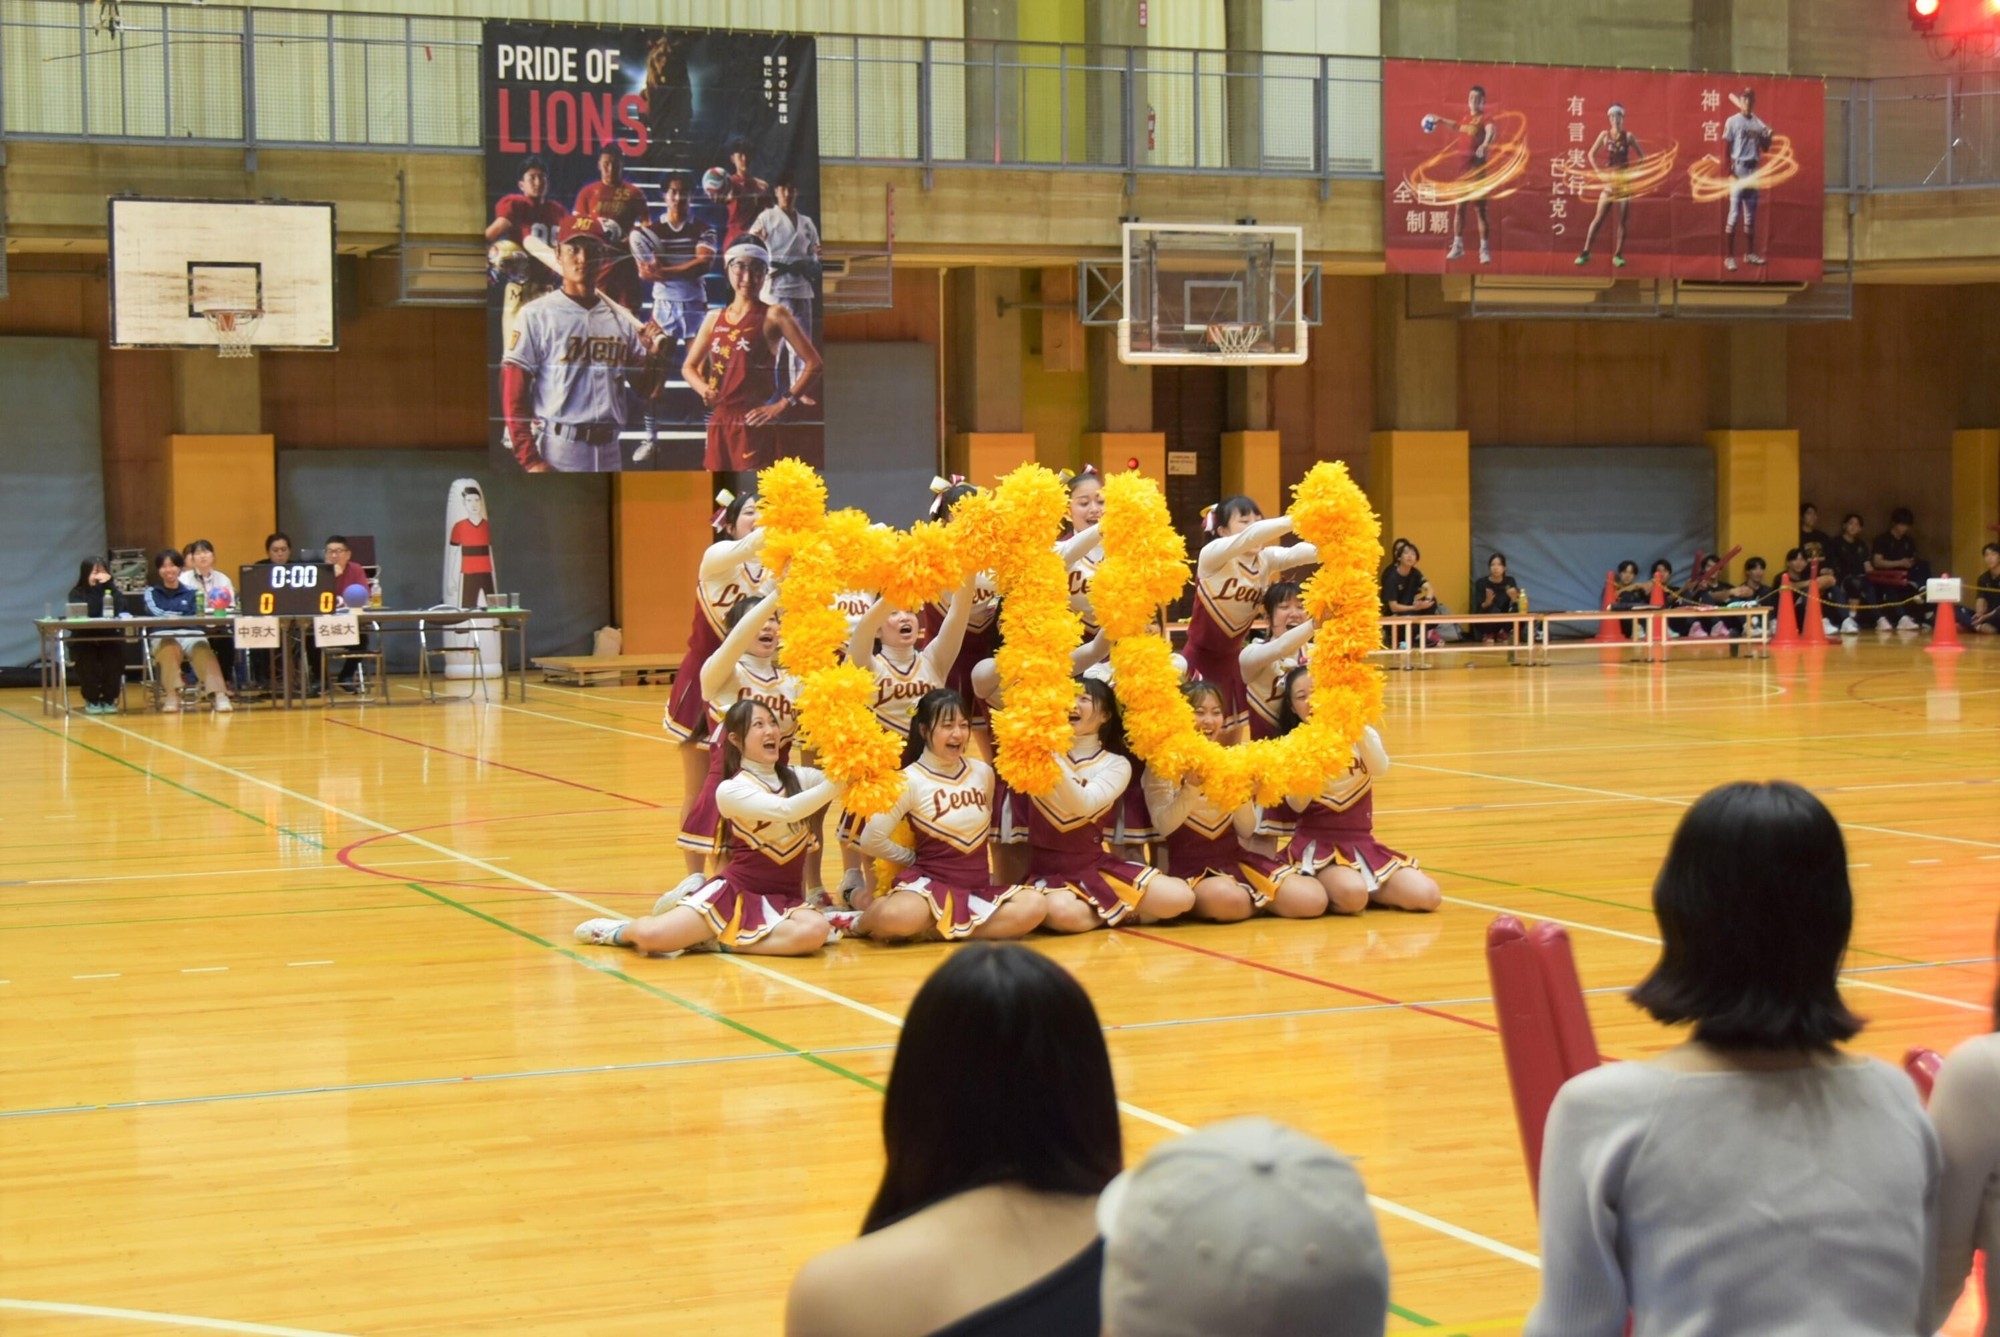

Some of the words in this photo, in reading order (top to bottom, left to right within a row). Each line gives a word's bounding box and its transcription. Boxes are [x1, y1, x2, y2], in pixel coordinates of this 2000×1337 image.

[498, 44, 578, 82] PRIDE
[586, 48, 621, 84] OF
[498, 89, 648, 157] LIONS
[1701, 88, 1721, 165] 神宮へ
[1567, 94, 1586, 197] 有言実行
[1393, 181, 1437, 205] 全国
[1406, 210, 1450, 234] 制覇
[273, 565, 317, 587] 0:00
[260, 593, 274, 614] 0
[320, 592, 334, 613] 0
[238, 625, 276, 639] 中京大
[318, 623, 356, 638] 名城大
